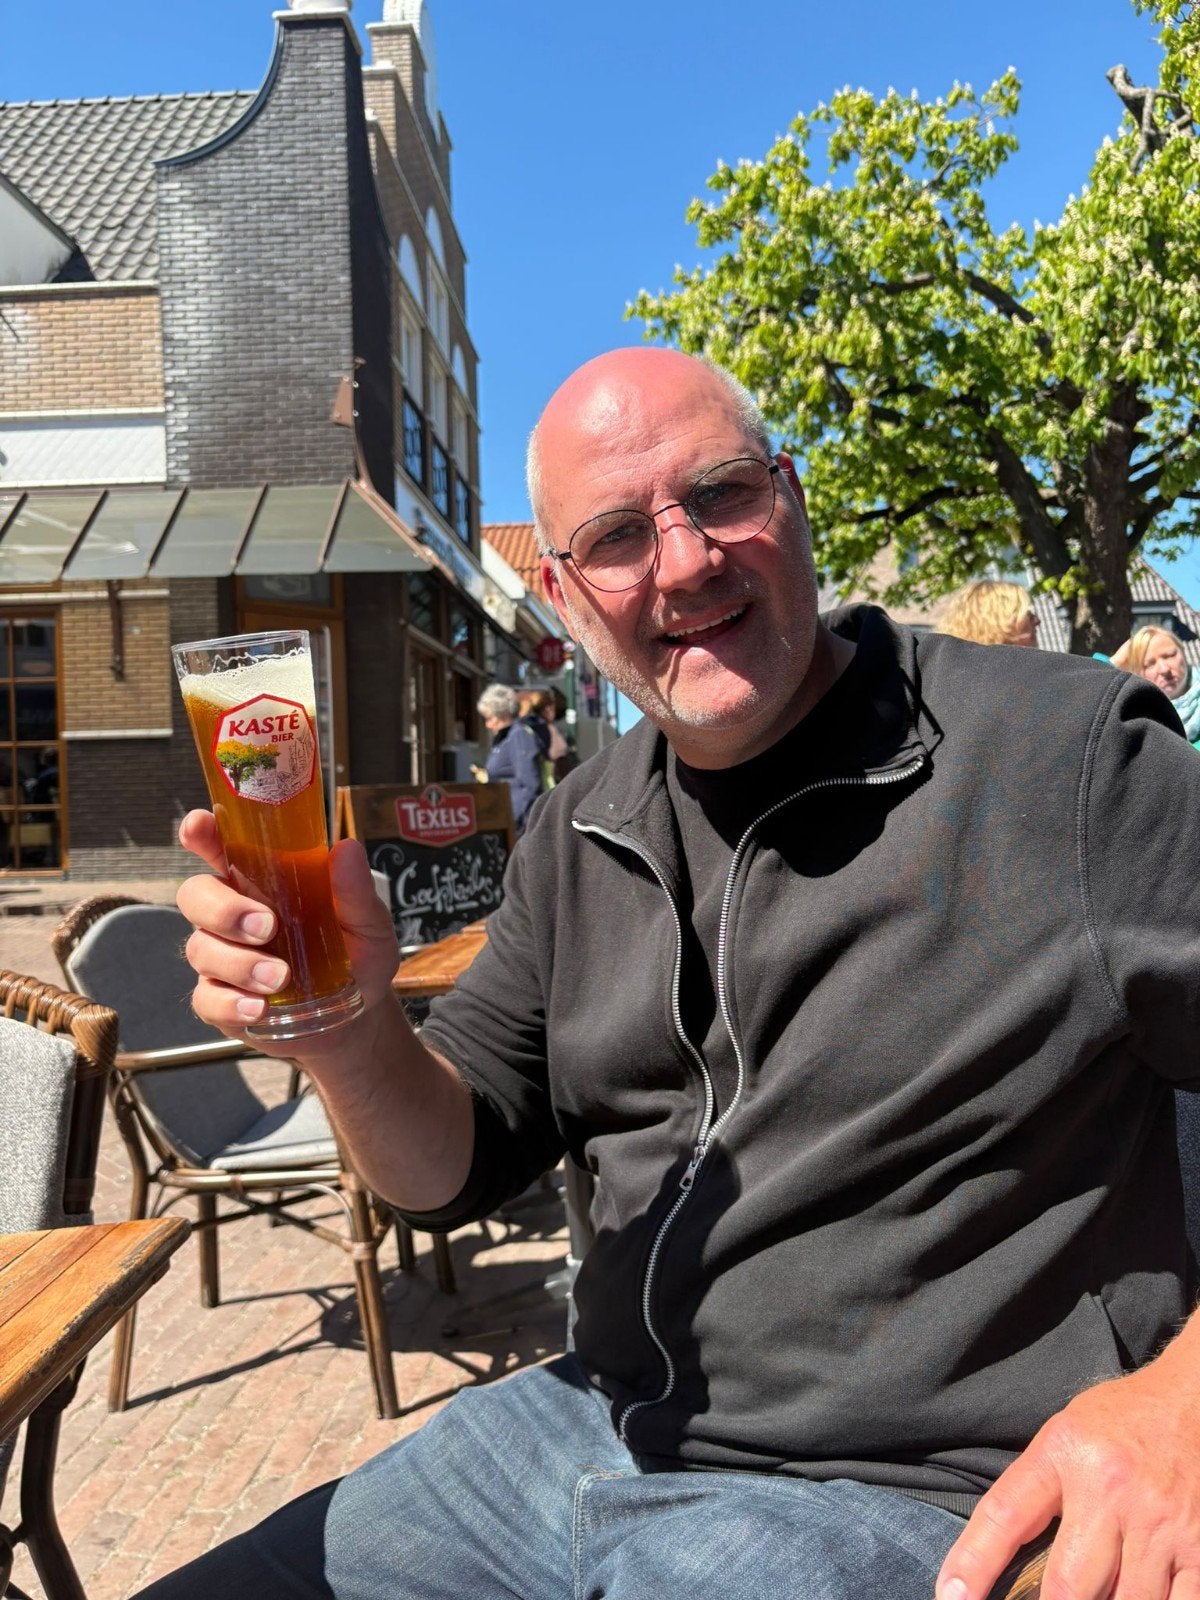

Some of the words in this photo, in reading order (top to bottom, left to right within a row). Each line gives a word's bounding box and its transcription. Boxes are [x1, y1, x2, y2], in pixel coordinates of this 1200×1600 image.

[228, 710, 300, 737] KASTÉ
[271, 732, 294, 743] BIER
[401, 803, 470, 831] TEXELS
